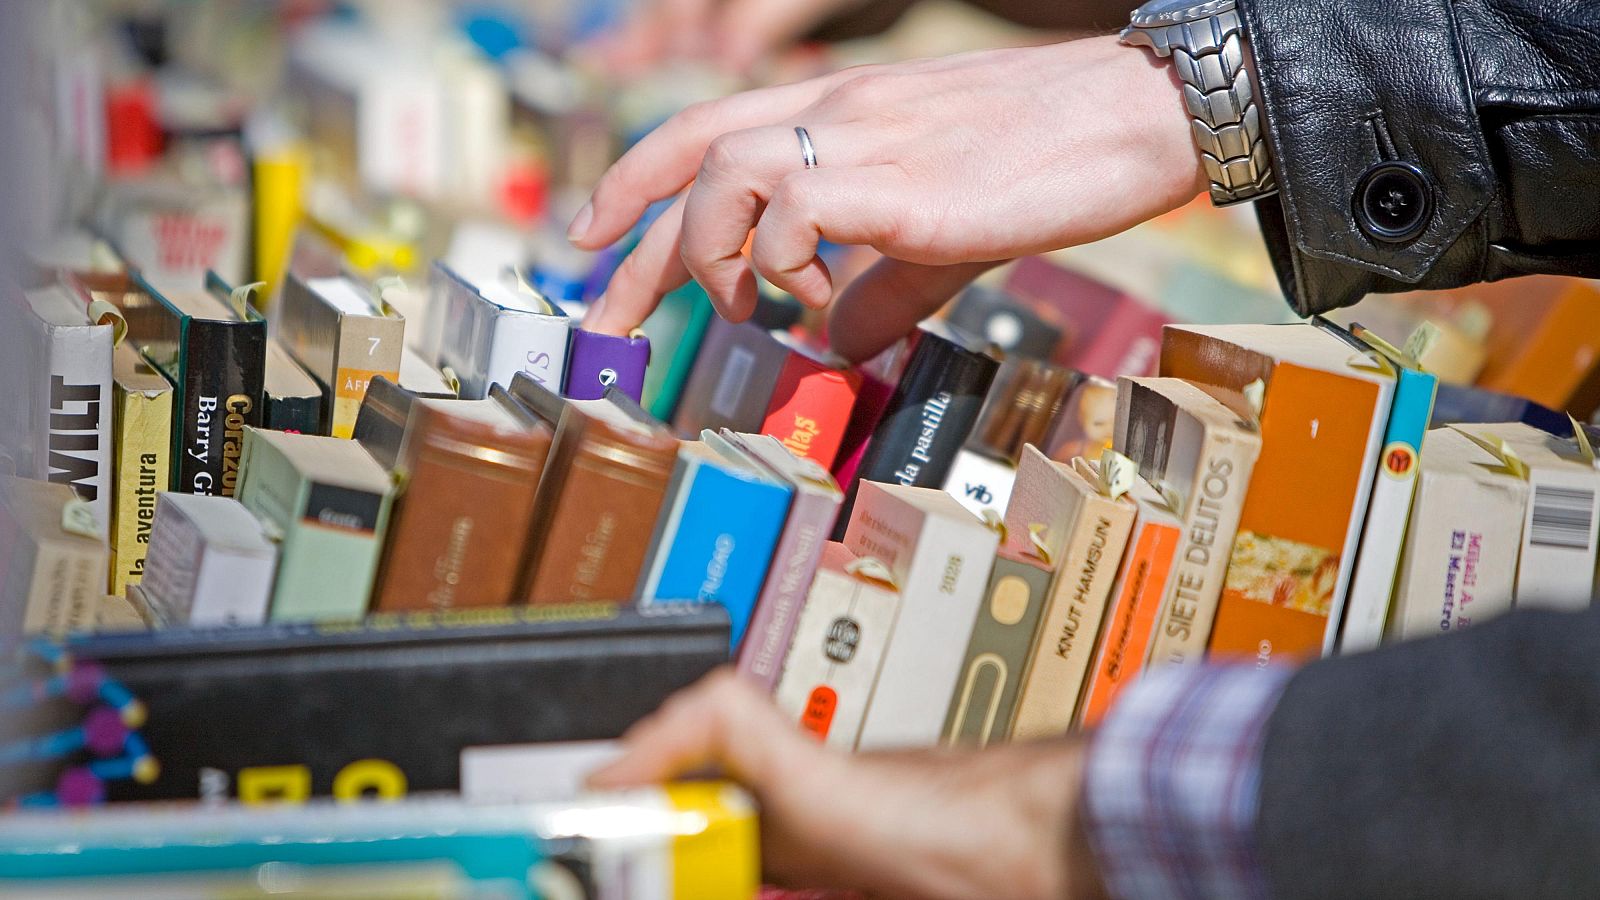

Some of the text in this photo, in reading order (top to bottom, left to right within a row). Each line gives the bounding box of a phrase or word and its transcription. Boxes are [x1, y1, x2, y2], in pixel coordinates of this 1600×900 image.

[367, 336, 381, 356] 7
[48, 374, 101, 502] WILT
[187, 396, 218, 464] Barry
[911, 391, 952, 463] pastilla
[128, 453, 156, 576] la aventura
[1164, 569, 1205, 642] SIETE
[1185, 456, 1234, 568] DELITOS
[1055, 515, 1112, 661] KNUT HAMSUN
[1440, 530, 1466, 630] El Maestro
[751, 597, 790, 677] Elizabeth
